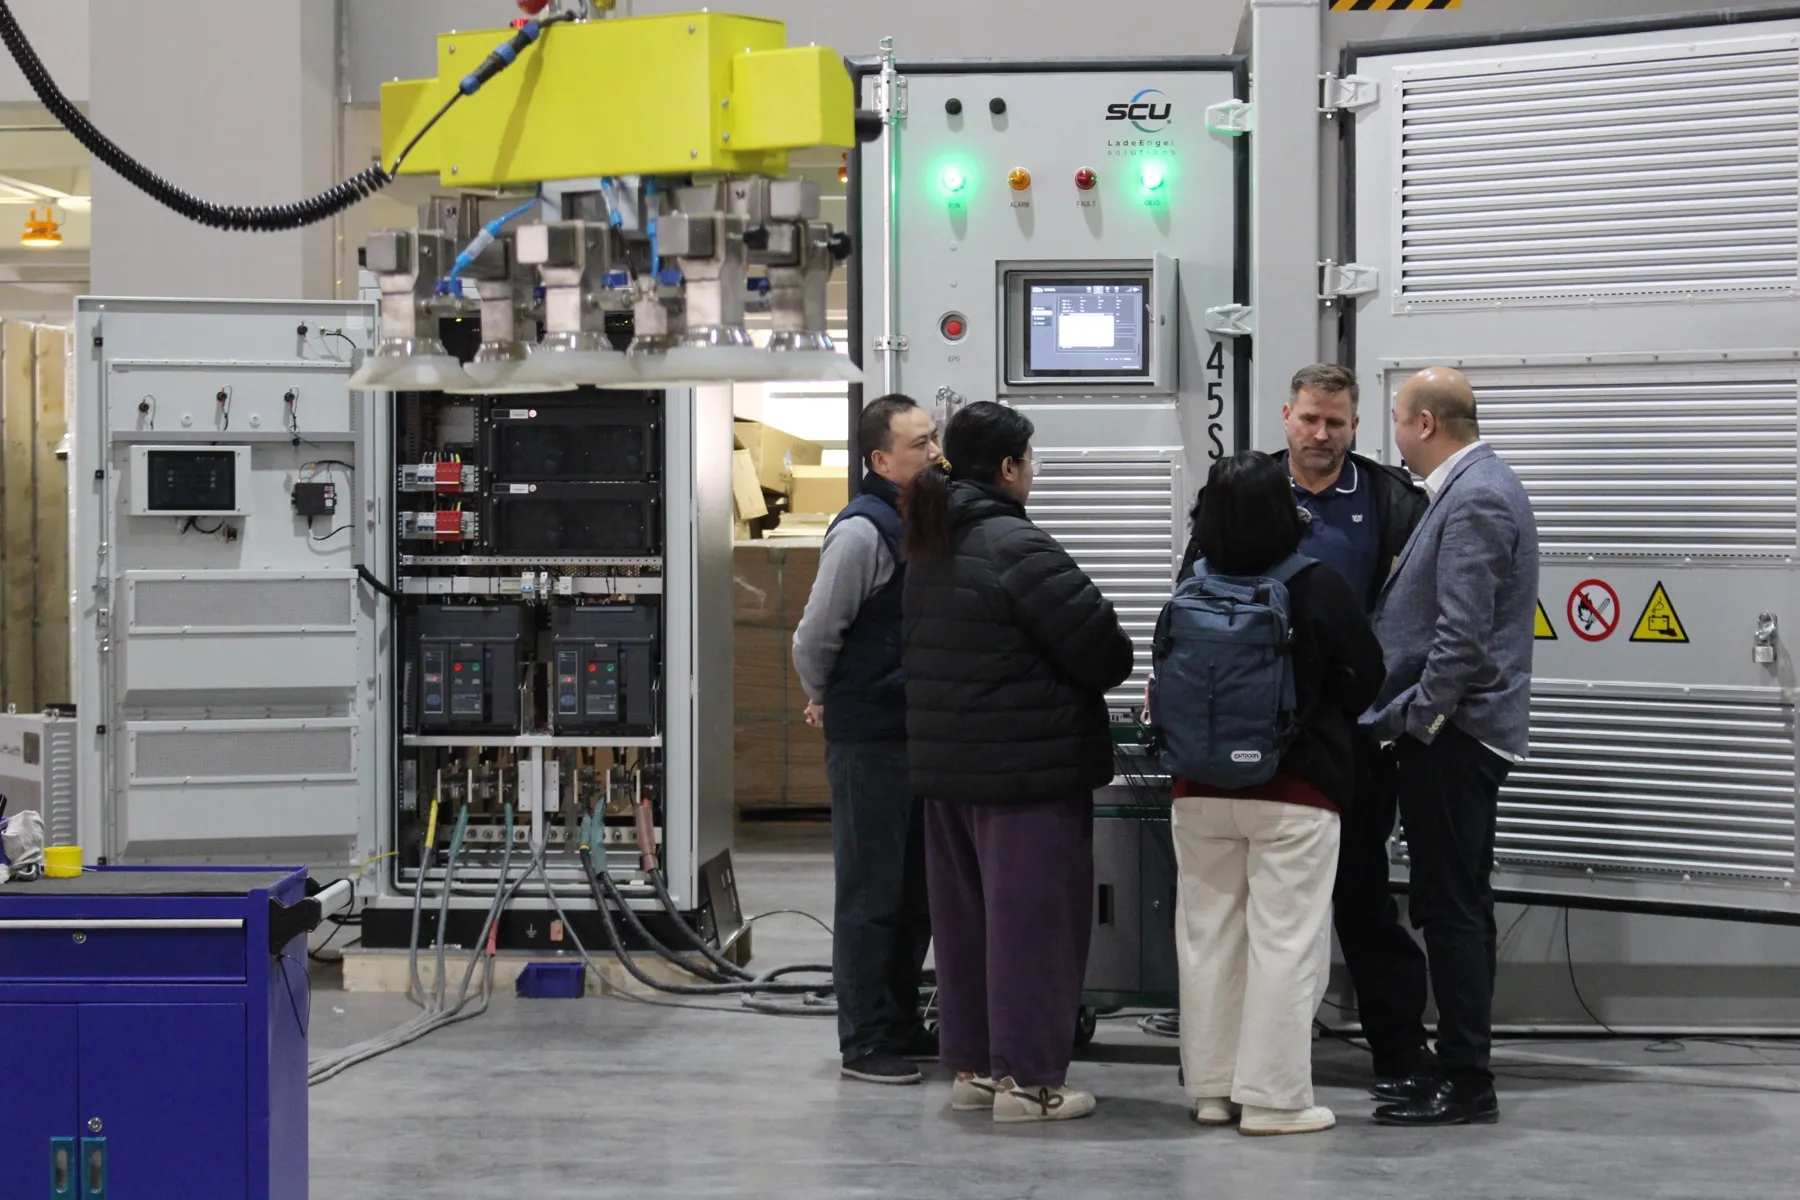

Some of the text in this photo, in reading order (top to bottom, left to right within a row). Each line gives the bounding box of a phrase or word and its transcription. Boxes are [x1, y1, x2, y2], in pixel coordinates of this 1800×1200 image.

[1105, 103, 1172, 120] SCU
[1107, 139, 1174, 147] LadeEngel
[1076, 200, 1096, 208] FAULT
[1144, 199, 1161, 207] GRID
